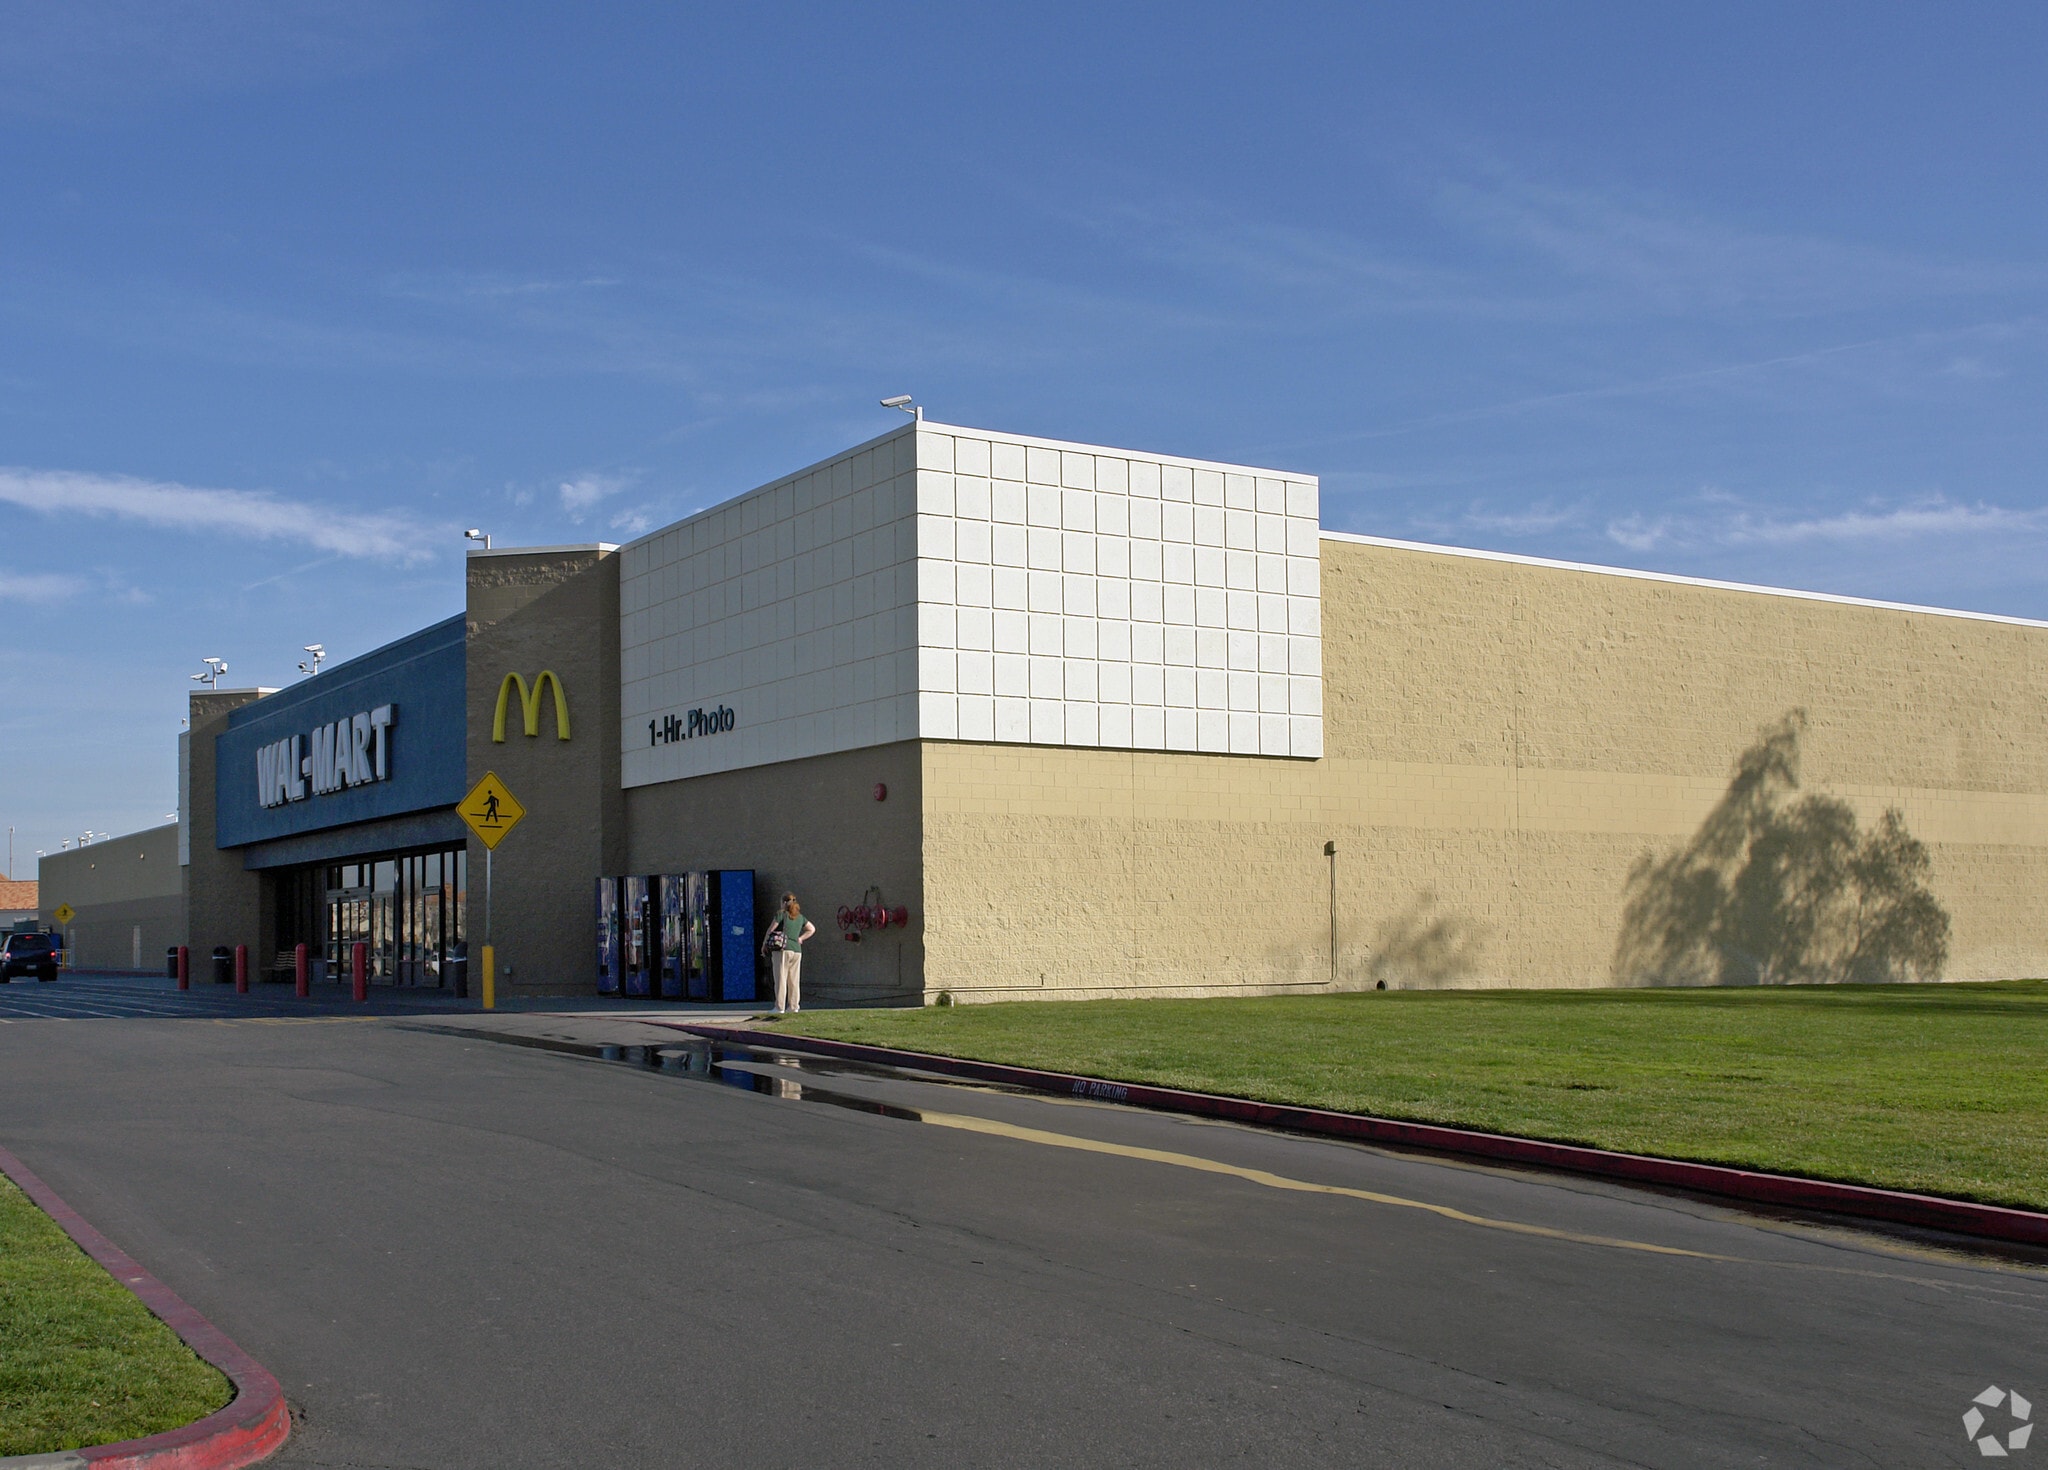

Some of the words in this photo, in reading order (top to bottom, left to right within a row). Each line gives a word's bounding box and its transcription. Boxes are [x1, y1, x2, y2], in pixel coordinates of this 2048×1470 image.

[687, 704, 735, 739] Photo
[256, 703, 394, 809] WAL-MART
[1072, 1080, 1087, 1093] NO
[1089, 1082, 1128, 1099] PARKING
